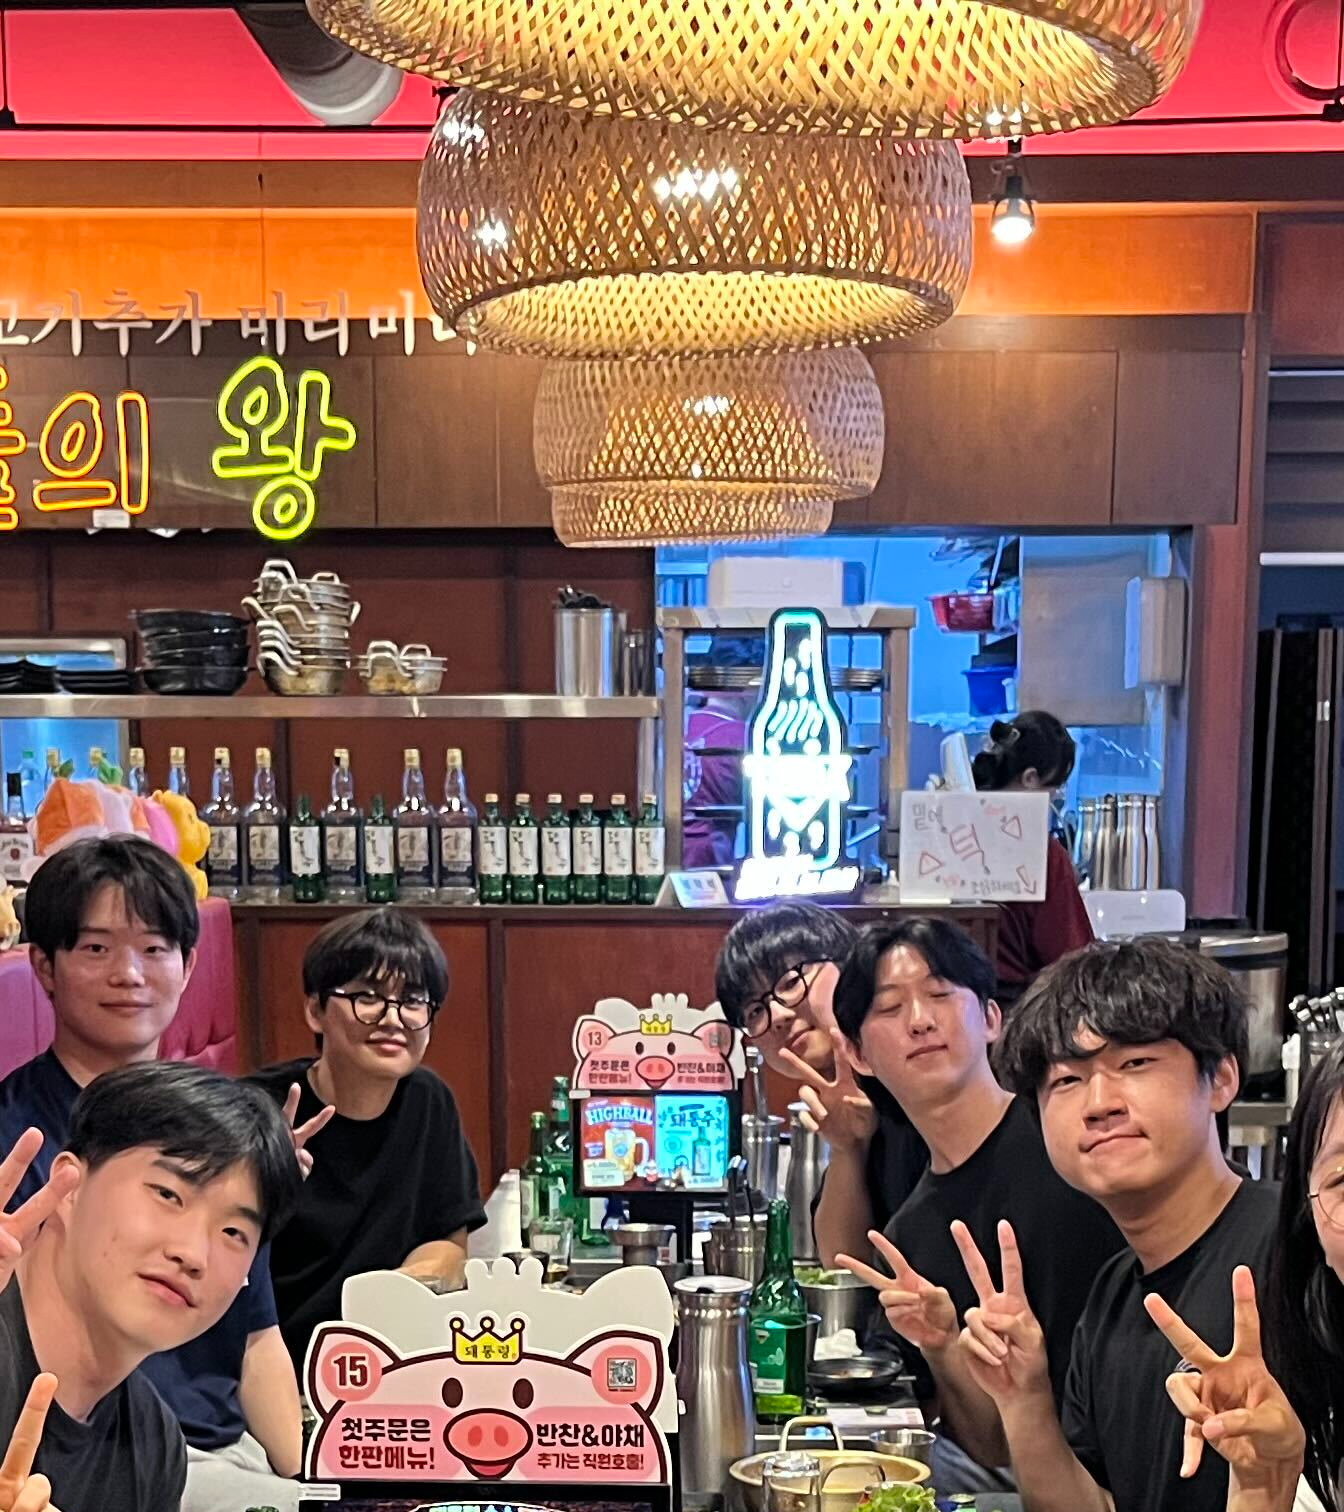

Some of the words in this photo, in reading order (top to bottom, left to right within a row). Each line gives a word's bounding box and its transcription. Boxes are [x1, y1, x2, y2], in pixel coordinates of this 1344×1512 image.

[211, 355, 357, 541] 왕
[587, 1031, 602, 1046] 13
[332, 1355, 368, 1387] 15
[341, 1418, 432, 1442] 첫주문은
[536, 1423, 645, 1448] 반찬&야채
[339, 1446, 436, 1470] 한판메뉴!
[537, 1453, 581, 1470] 추가는
